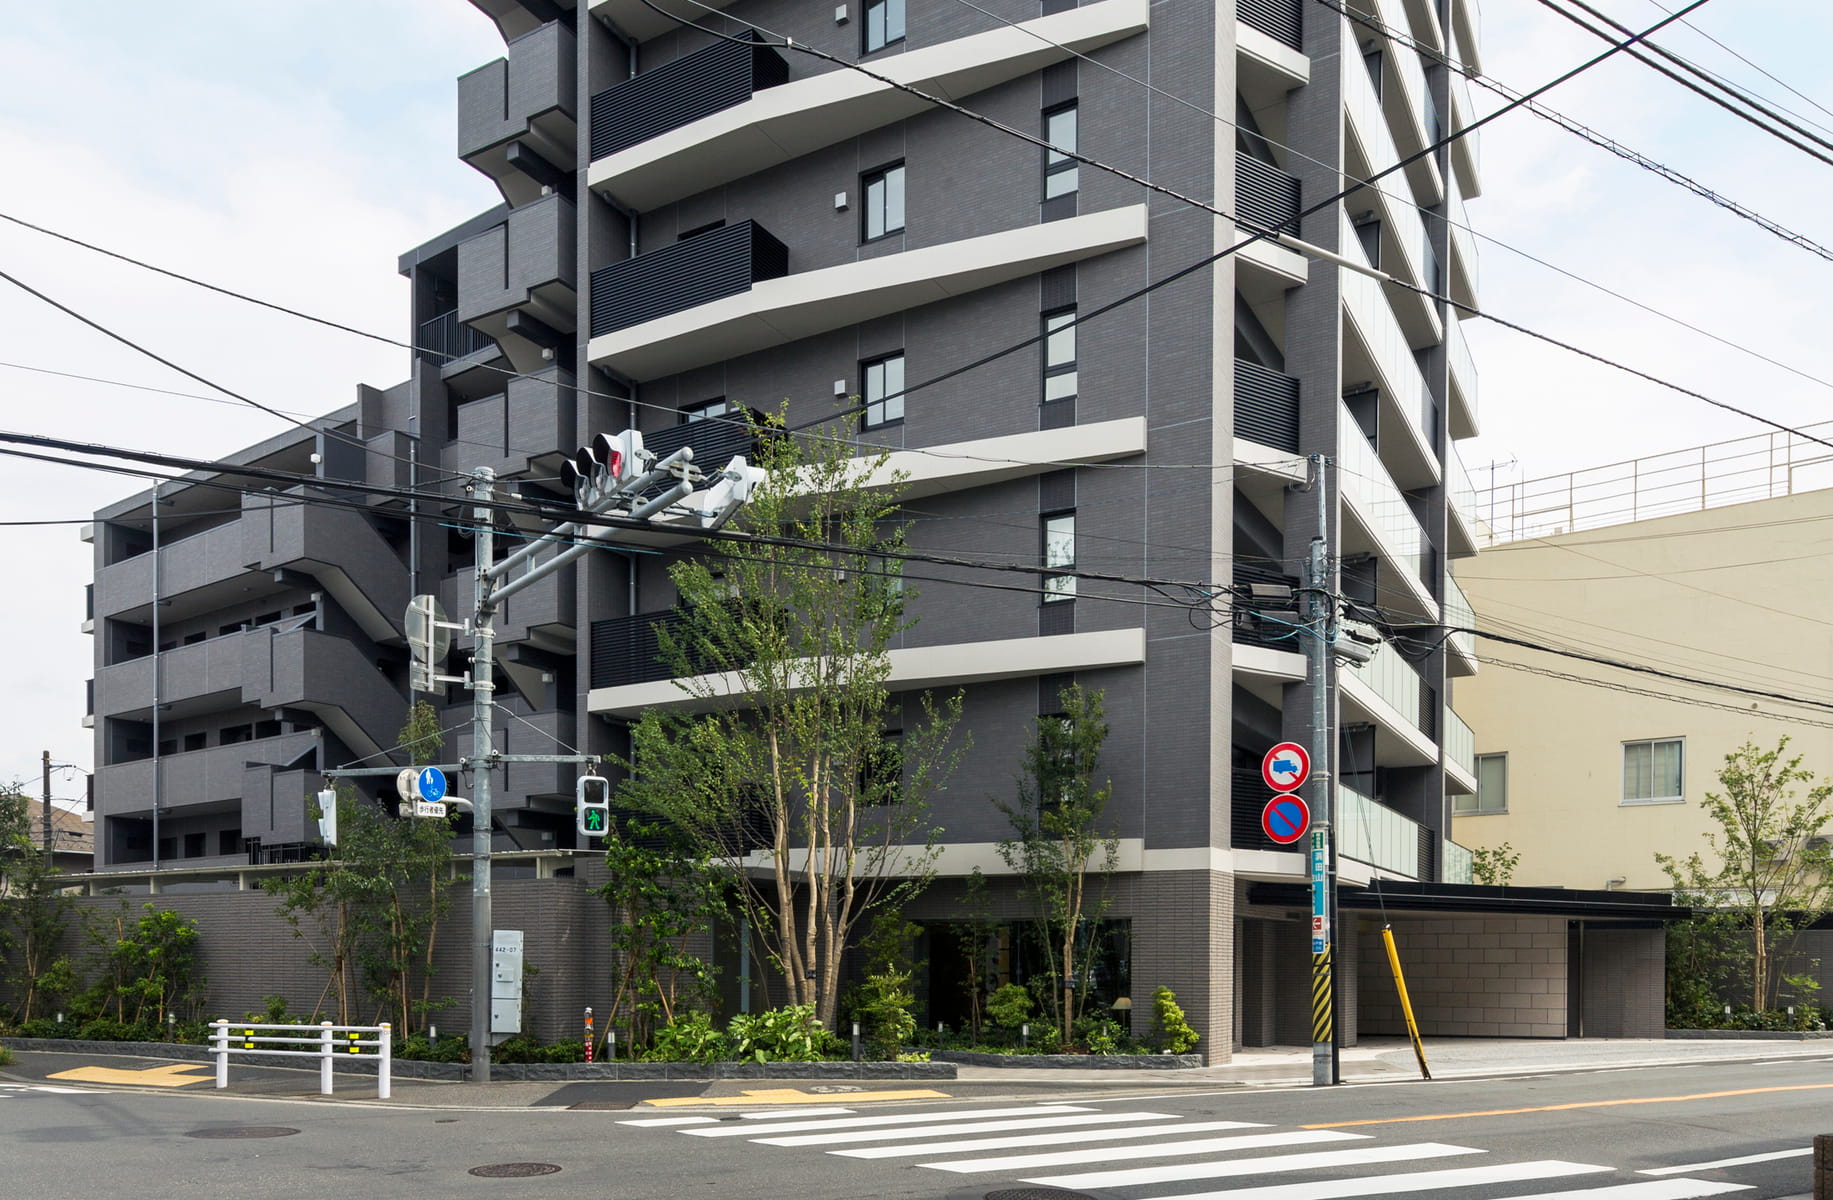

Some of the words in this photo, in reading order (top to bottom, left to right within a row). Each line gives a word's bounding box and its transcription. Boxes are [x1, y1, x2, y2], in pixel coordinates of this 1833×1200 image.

[420, 806, 444, 815] 歩行者優先
